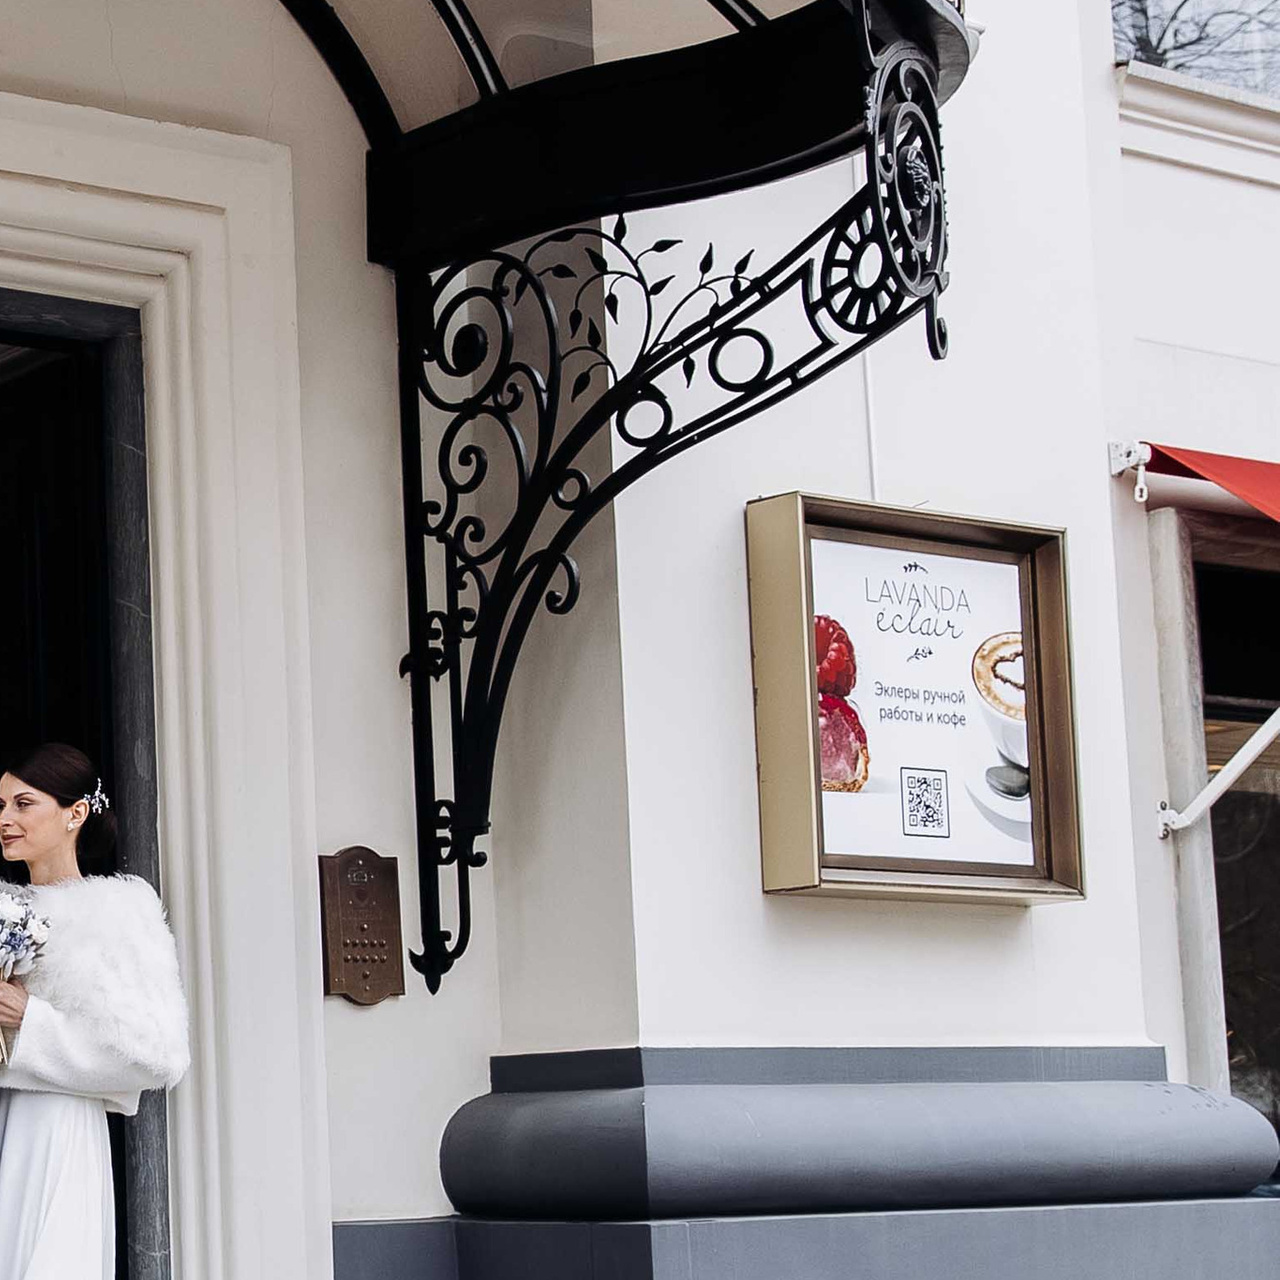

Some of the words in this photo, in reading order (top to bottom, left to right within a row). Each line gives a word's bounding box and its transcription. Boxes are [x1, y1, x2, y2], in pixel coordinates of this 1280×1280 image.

[864, 576, 972, 614] LAVANDA
[874, 680, 921, 702] Эклеры
[923, 689, 966, 705] ручной
[879, 705, 923, 722] работы
[926, 712, 934, 723] и
[937, 711, 967, 729] кофе
